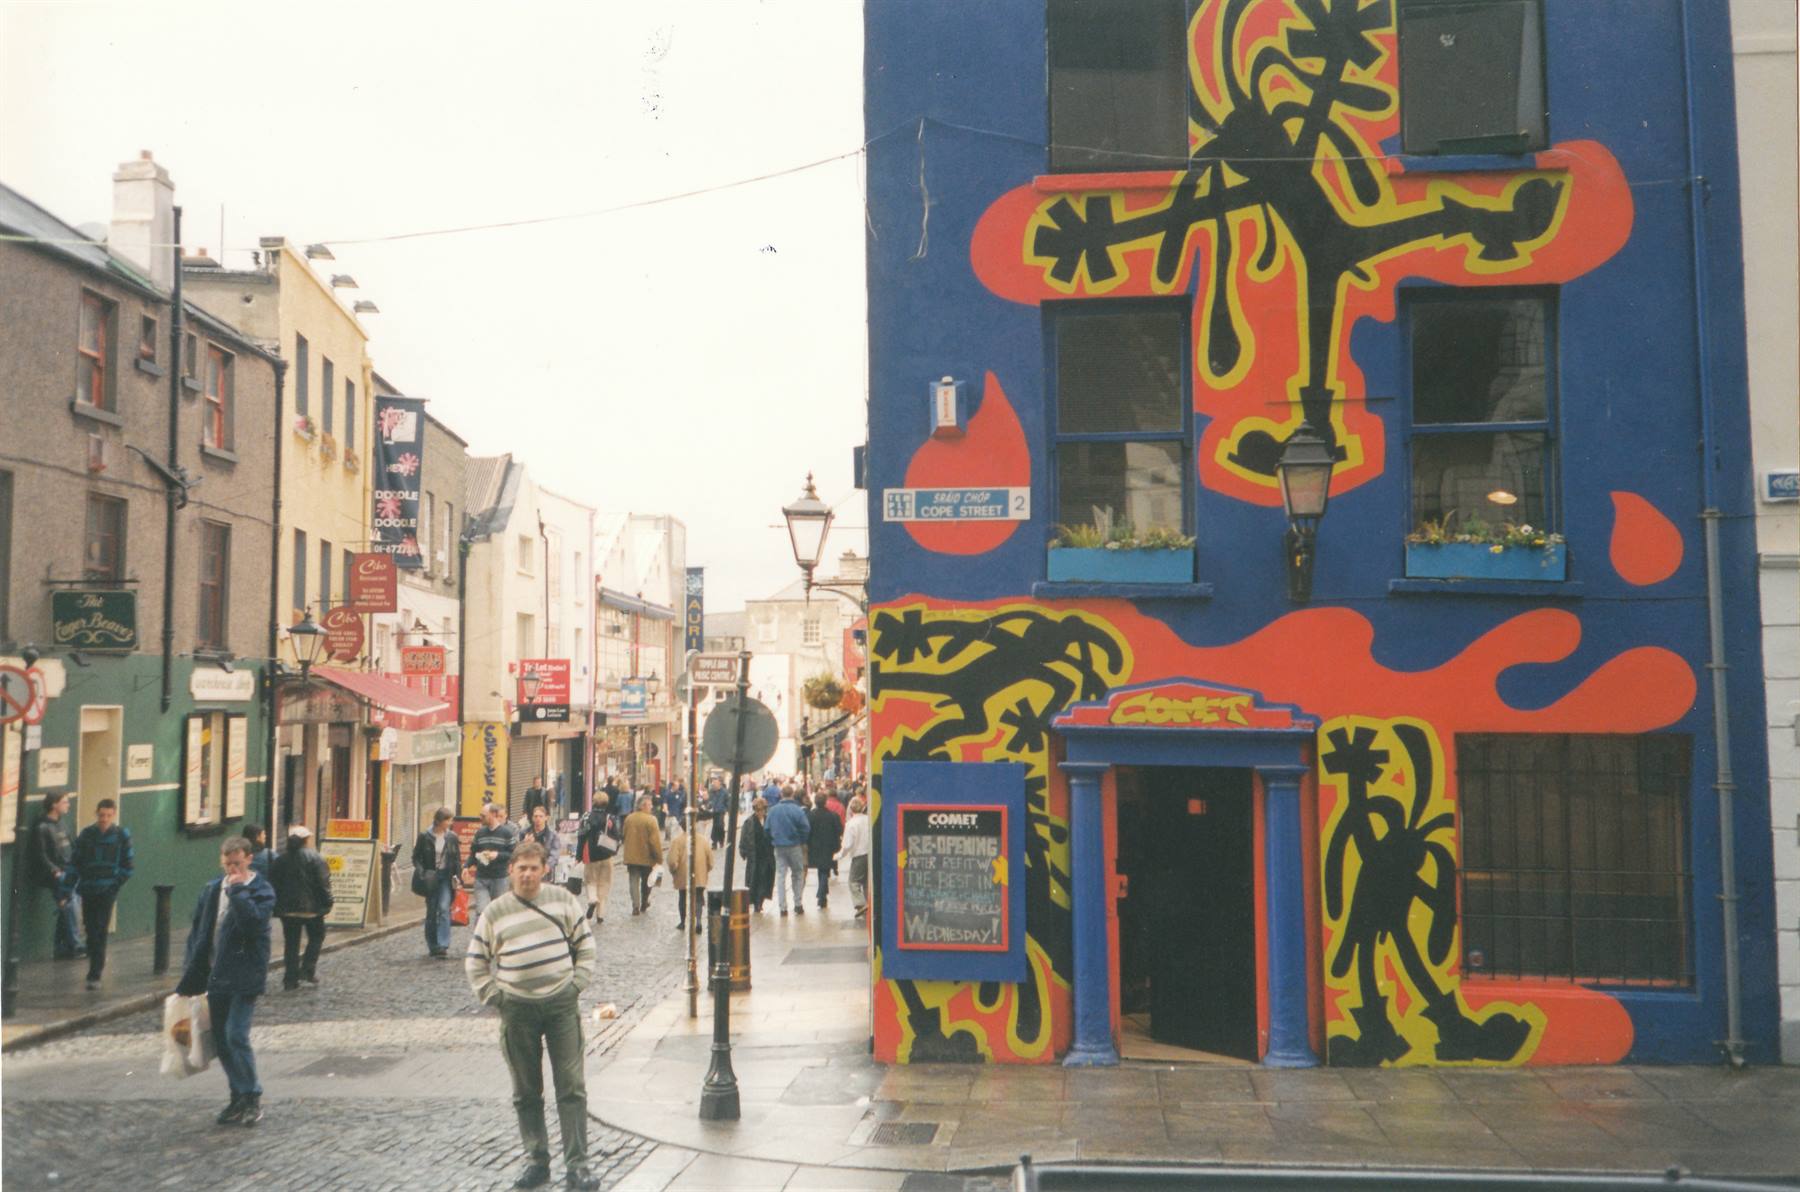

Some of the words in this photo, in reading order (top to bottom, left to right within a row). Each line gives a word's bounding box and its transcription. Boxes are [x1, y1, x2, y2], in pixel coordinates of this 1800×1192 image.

[375, 489, 418, 500] DOODLE
[920, 505, 954, 517] COPE
[960, 504, 1003, 517] STREET
[1013, 496, 1025, 511] 2
[374, 519, 416, 528] DOODLE
[1110, 692, 1253, 726] COMET
[928, 813, 978, 825] COMET
[908, 835, 998, 856] RE-OPENING
[909, 857, 936, 869] AFTER
[942, 857, 973, 871] REFIT
[905, 871, 931, 889] THE
[938, 871, 975, 889] BEST
[978, 874, 993, 889] IN
